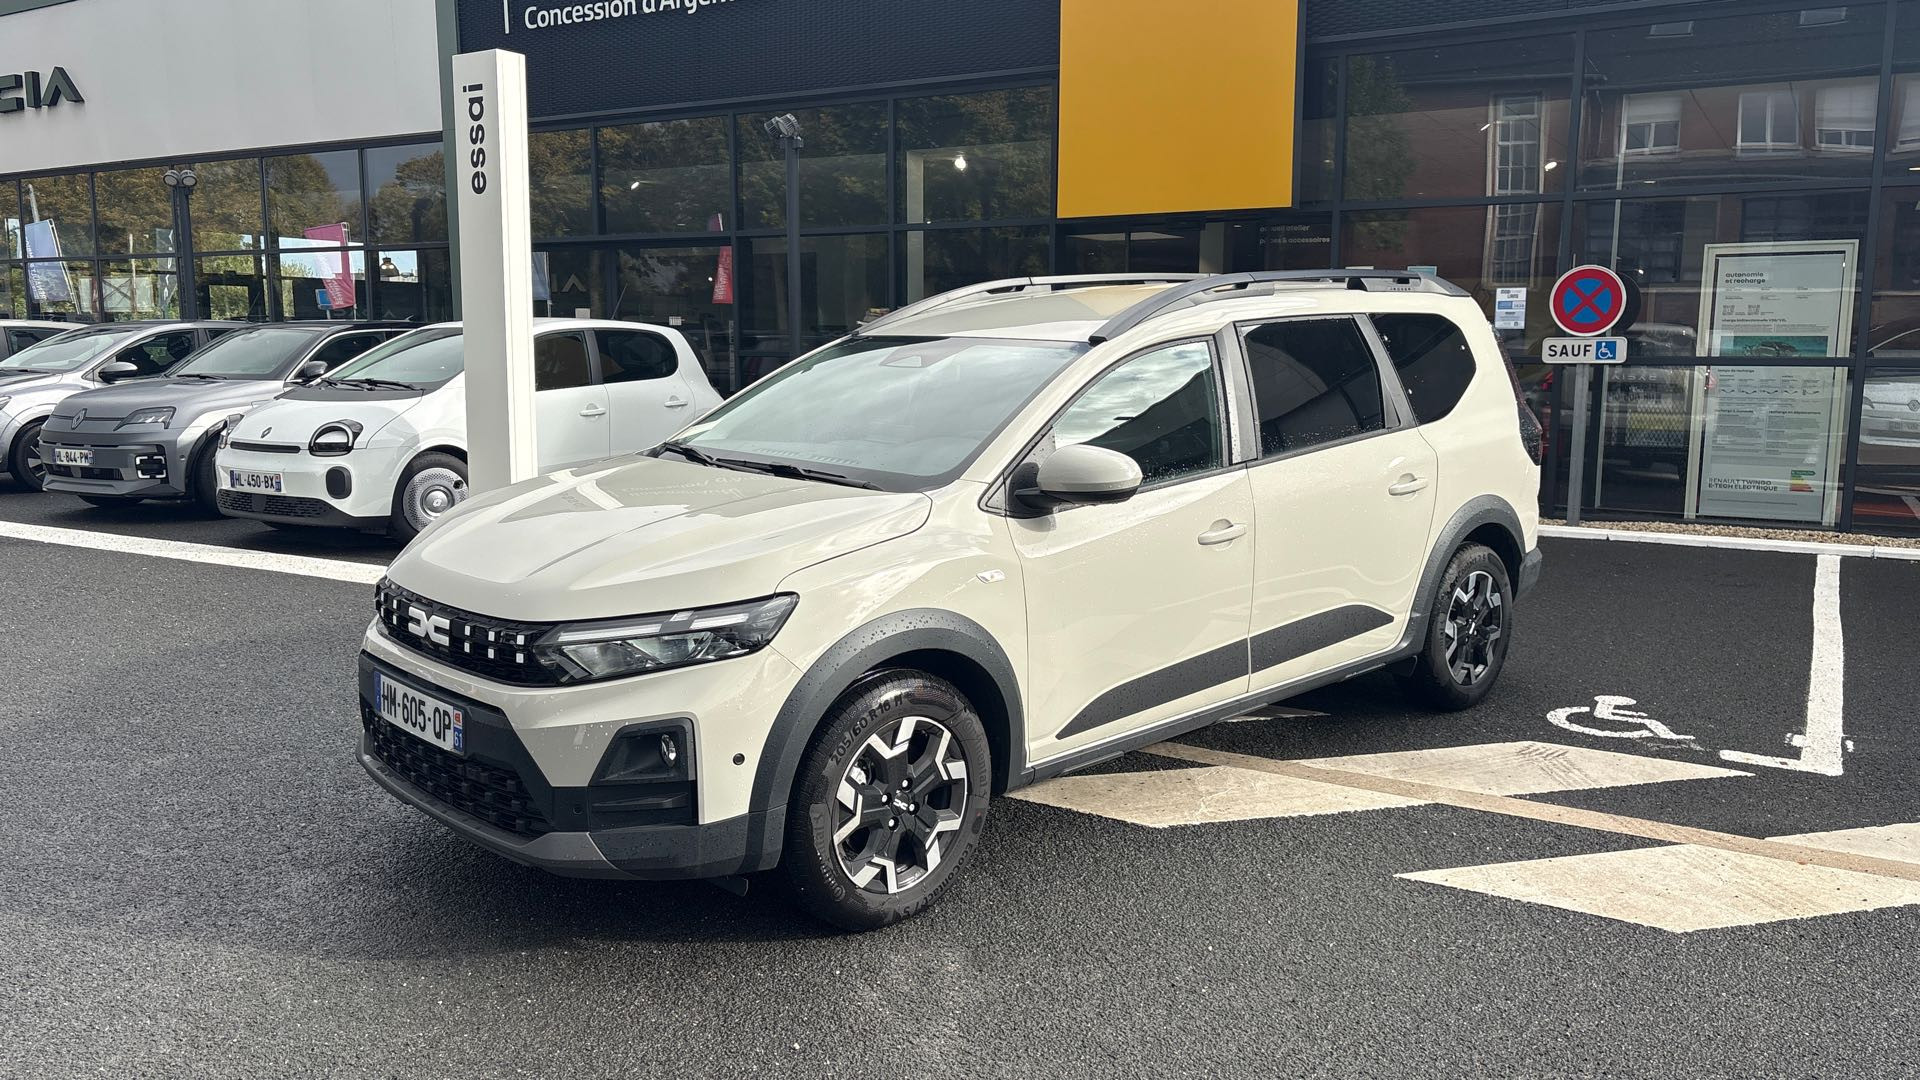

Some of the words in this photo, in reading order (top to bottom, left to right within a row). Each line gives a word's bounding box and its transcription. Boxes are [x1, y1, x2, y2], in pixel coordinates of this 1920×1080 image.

[524, 0, 637, 29] Concession
[463, 83, 487, 195] essai
[1548, 344, 1592, 357] SAUF
[235, 472, 274, 489] HL-450-BX
[382, 681, 452, 742] HM-605-QP
[454, 731, 463, 748] 61
[830, 716, 868, 766] 205/60
